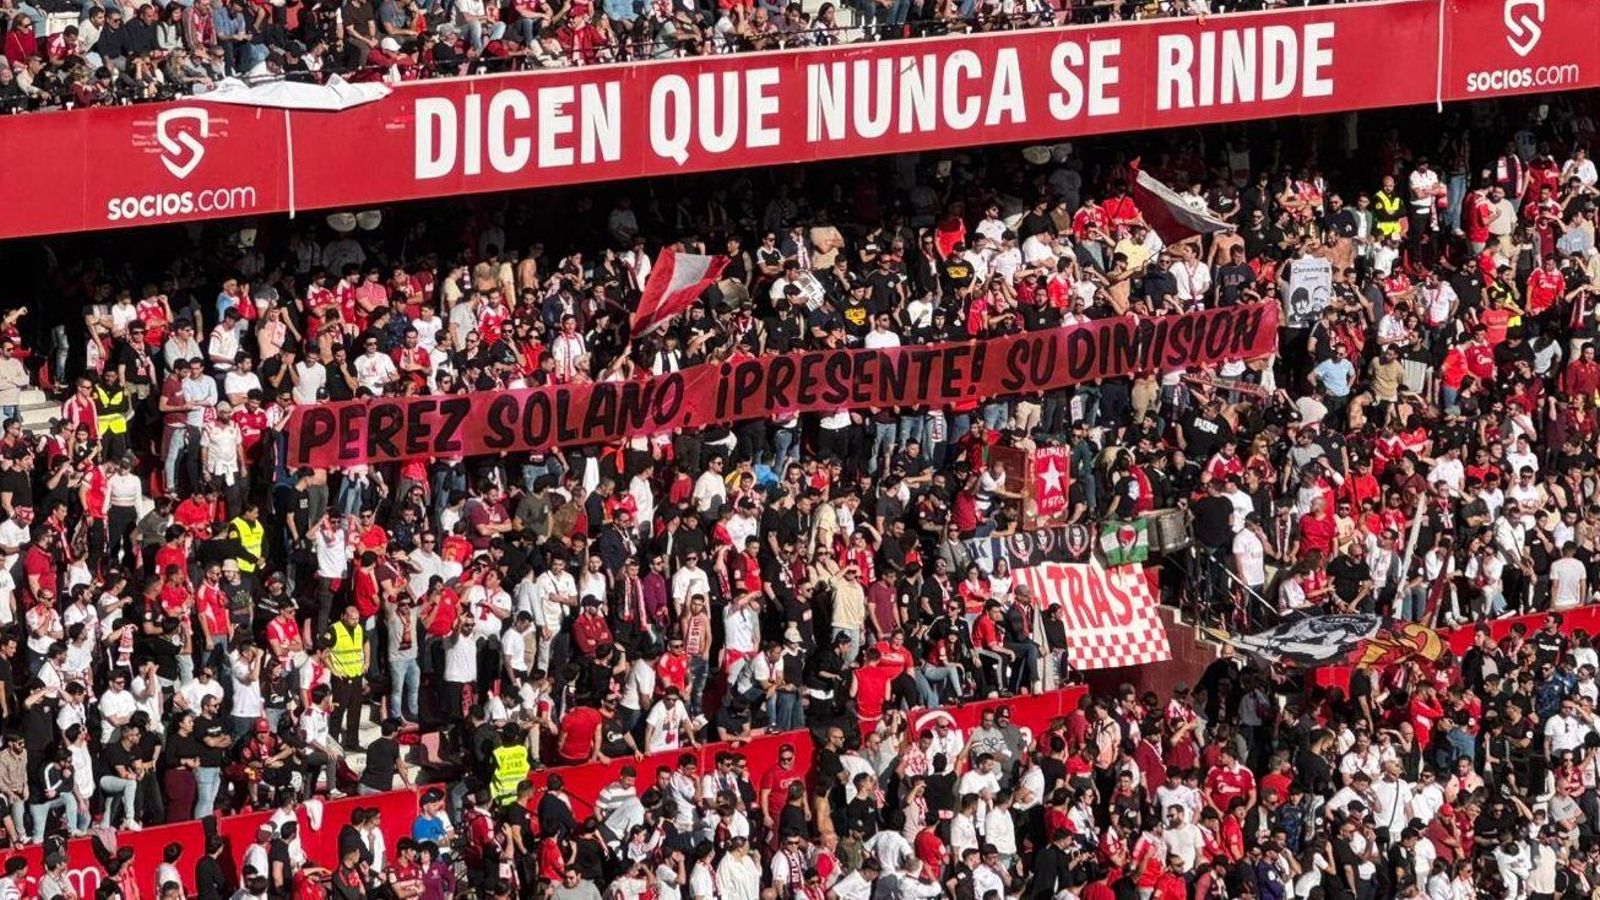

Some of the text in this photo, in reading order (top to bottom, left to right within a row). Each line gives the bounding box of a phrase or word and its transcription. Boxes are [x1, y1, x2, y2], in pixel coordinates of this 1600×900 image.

[414, 21, 1335, 180] DICEN QUE NUNCA SE RINDE
[1465, 63, 1580, 92] SOCIOS.com
[106, 185, 257, 221] SOCIOS.com
[482, 373, 692, 450] SOLANO,
[715, 342, 988, 419] ¡PRESENTE!
[1001, 337, 1058, 391] SU
